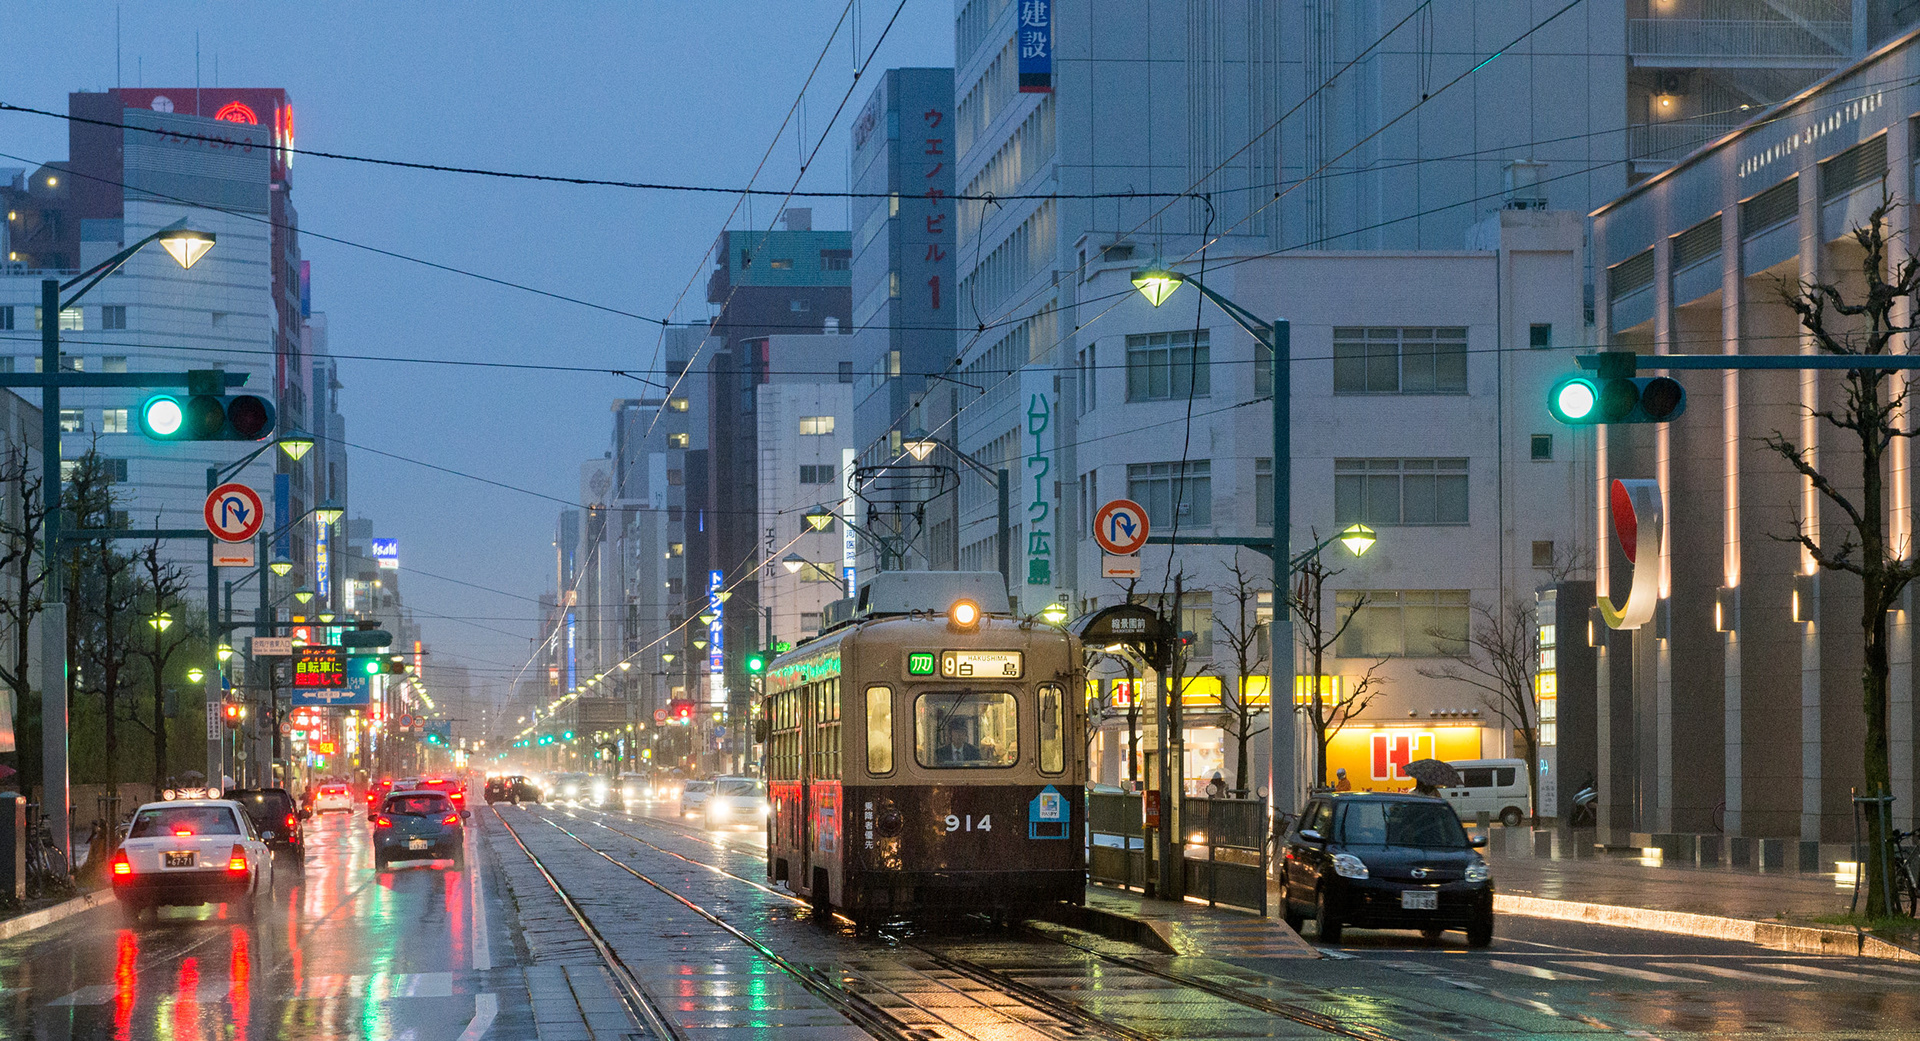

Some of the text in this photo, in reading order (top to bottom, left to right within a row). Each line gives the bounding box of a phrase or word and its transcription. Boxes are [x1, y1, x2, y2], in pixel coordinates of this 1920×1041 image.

[1021, 0, 1049, 59] 建設
[1027, 393, 1051, 585] ハローワーク広島
[765, 528, 776, 577] エイトビル
[296, 661, 343, 673] 自転車に
[945, 657, 955, 675] 9
[295, 672, 343, 685] 注意して
[945, 814, 992, 831] 914
